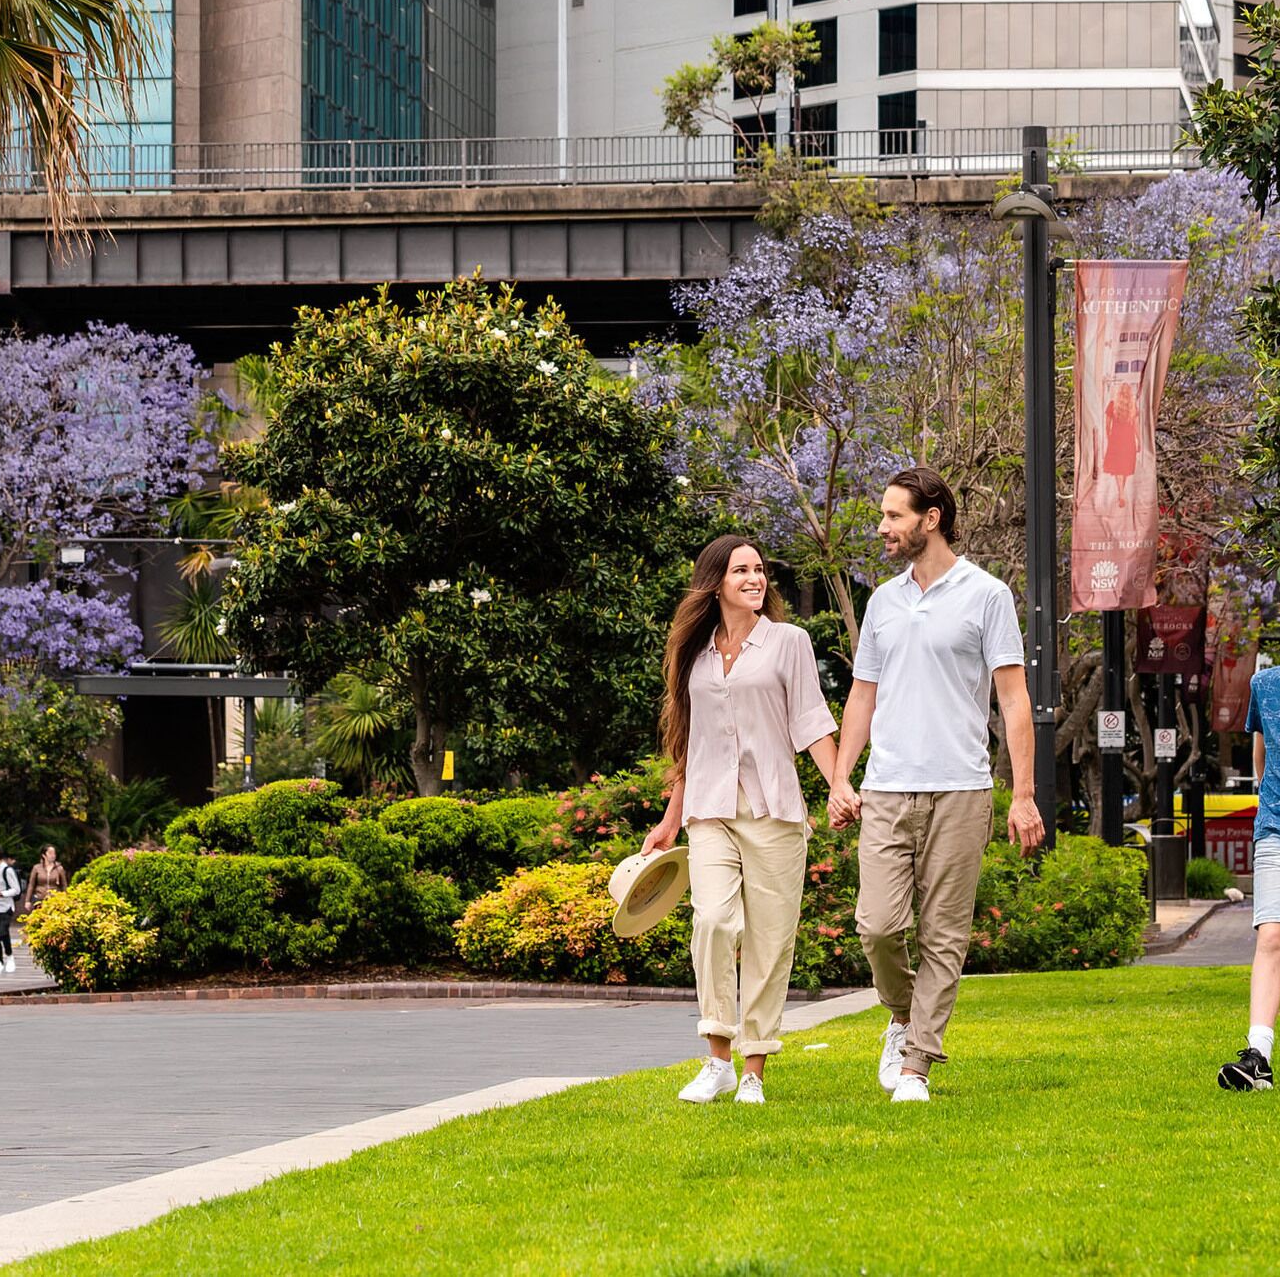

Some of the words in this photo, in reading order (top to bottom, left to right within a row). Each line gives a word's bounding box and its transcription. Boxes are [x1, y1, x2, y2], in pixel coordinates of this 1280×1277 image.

[1084, 286, 1177, 297] EFORTLESSLY
[1079, 297, 1179, 315] AUTHENTIC
[1089, 541, 1113, 551] THE
[1091, 578, 1118, 589] NSW
